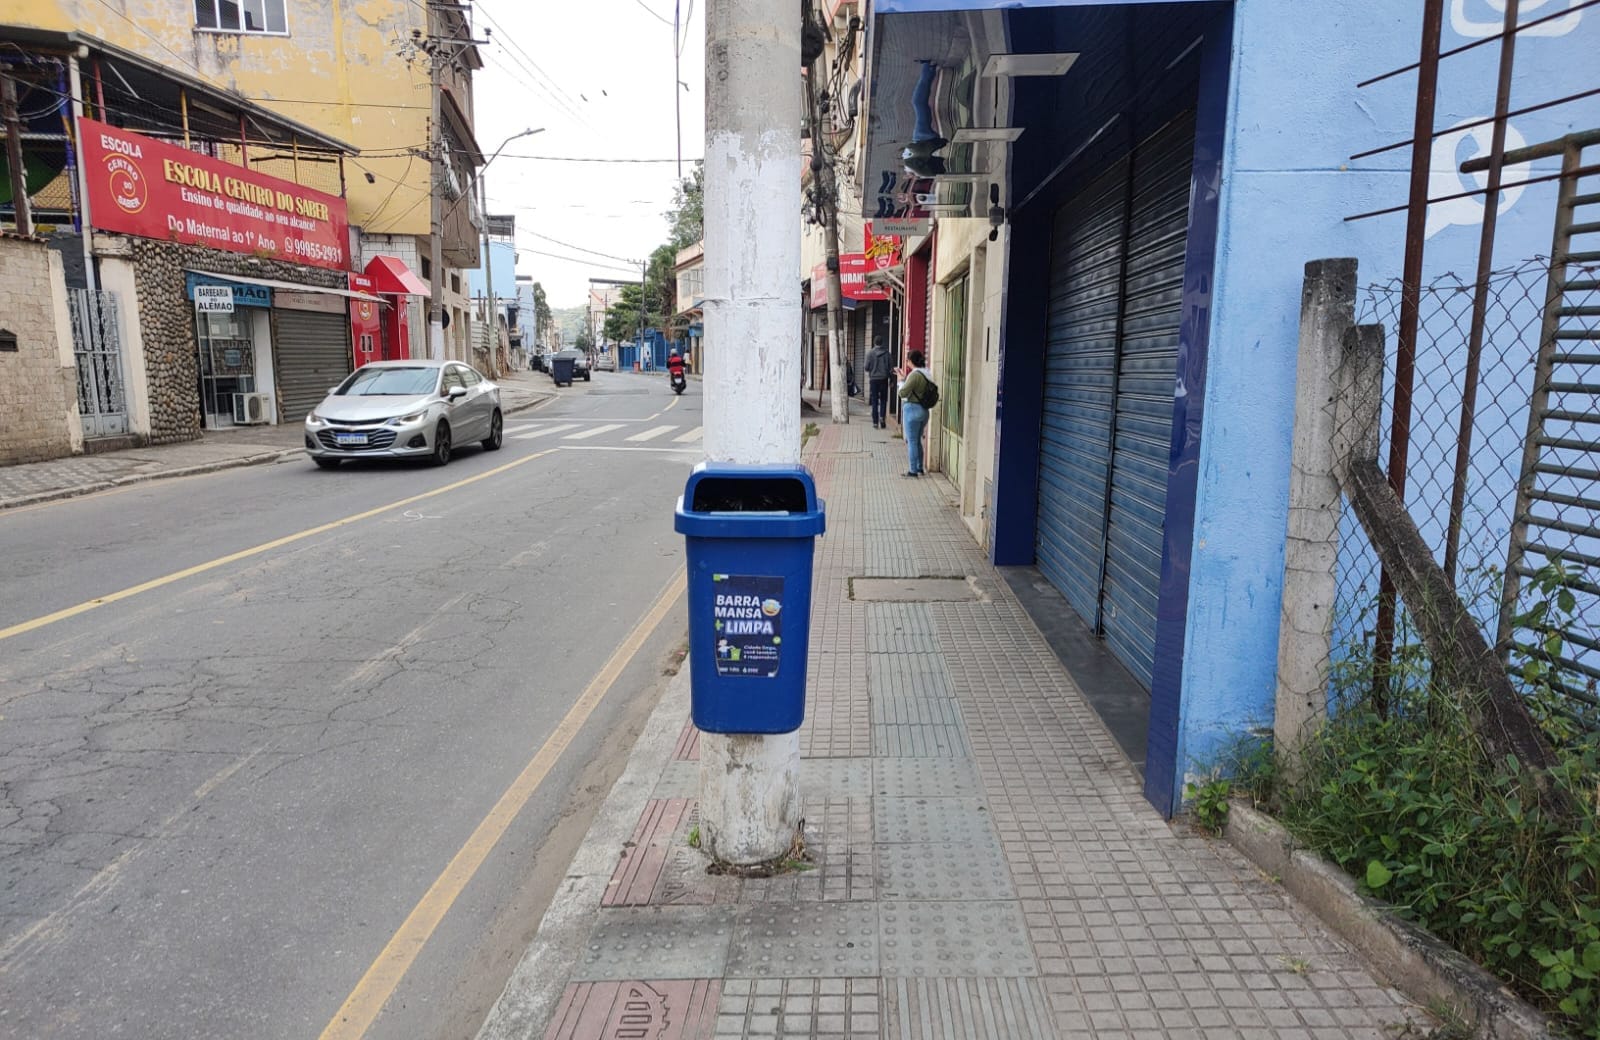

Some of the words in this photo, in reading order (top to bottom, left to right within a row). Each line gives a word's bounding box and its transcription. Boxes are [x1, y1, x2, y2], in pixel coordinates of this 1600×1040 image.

[101, 134, 142, 158] ESCOLA
[107, 158, 138, 181] CENTRO
[163, 158, 223, 194] ESCOLA
[224, 176, 274, 208] CENTRO
[275, 191, 294, 213] DO
[295, 197, 328, 221] SABER
[117, 194, 140, 208] SABER
[180, 187, 212, 208] Ensino
[214, 196, 224, 210] de
[226, 201, 264, 219] qualidade
[265, 212, 275, 222] ao
[276, 214, 288, 226] seu
[289, 216, 316, 231] alcance!
[167, 214, 184, 234] Do
[186, 218, 230, 241] Maternal
[232, 230, 245, 244] ao
[245, 230, 255, 245] 1º
[258, 234, 276, 250] Ano
[294, 239, 343, 263] 99955-2931
[198, 288, 228, 297] BARBEARIA
[717, 595, 760, 607] BARRA
[715, 607, 762, 618] MANSA
[726, 620, 773, 633] LIMPA
